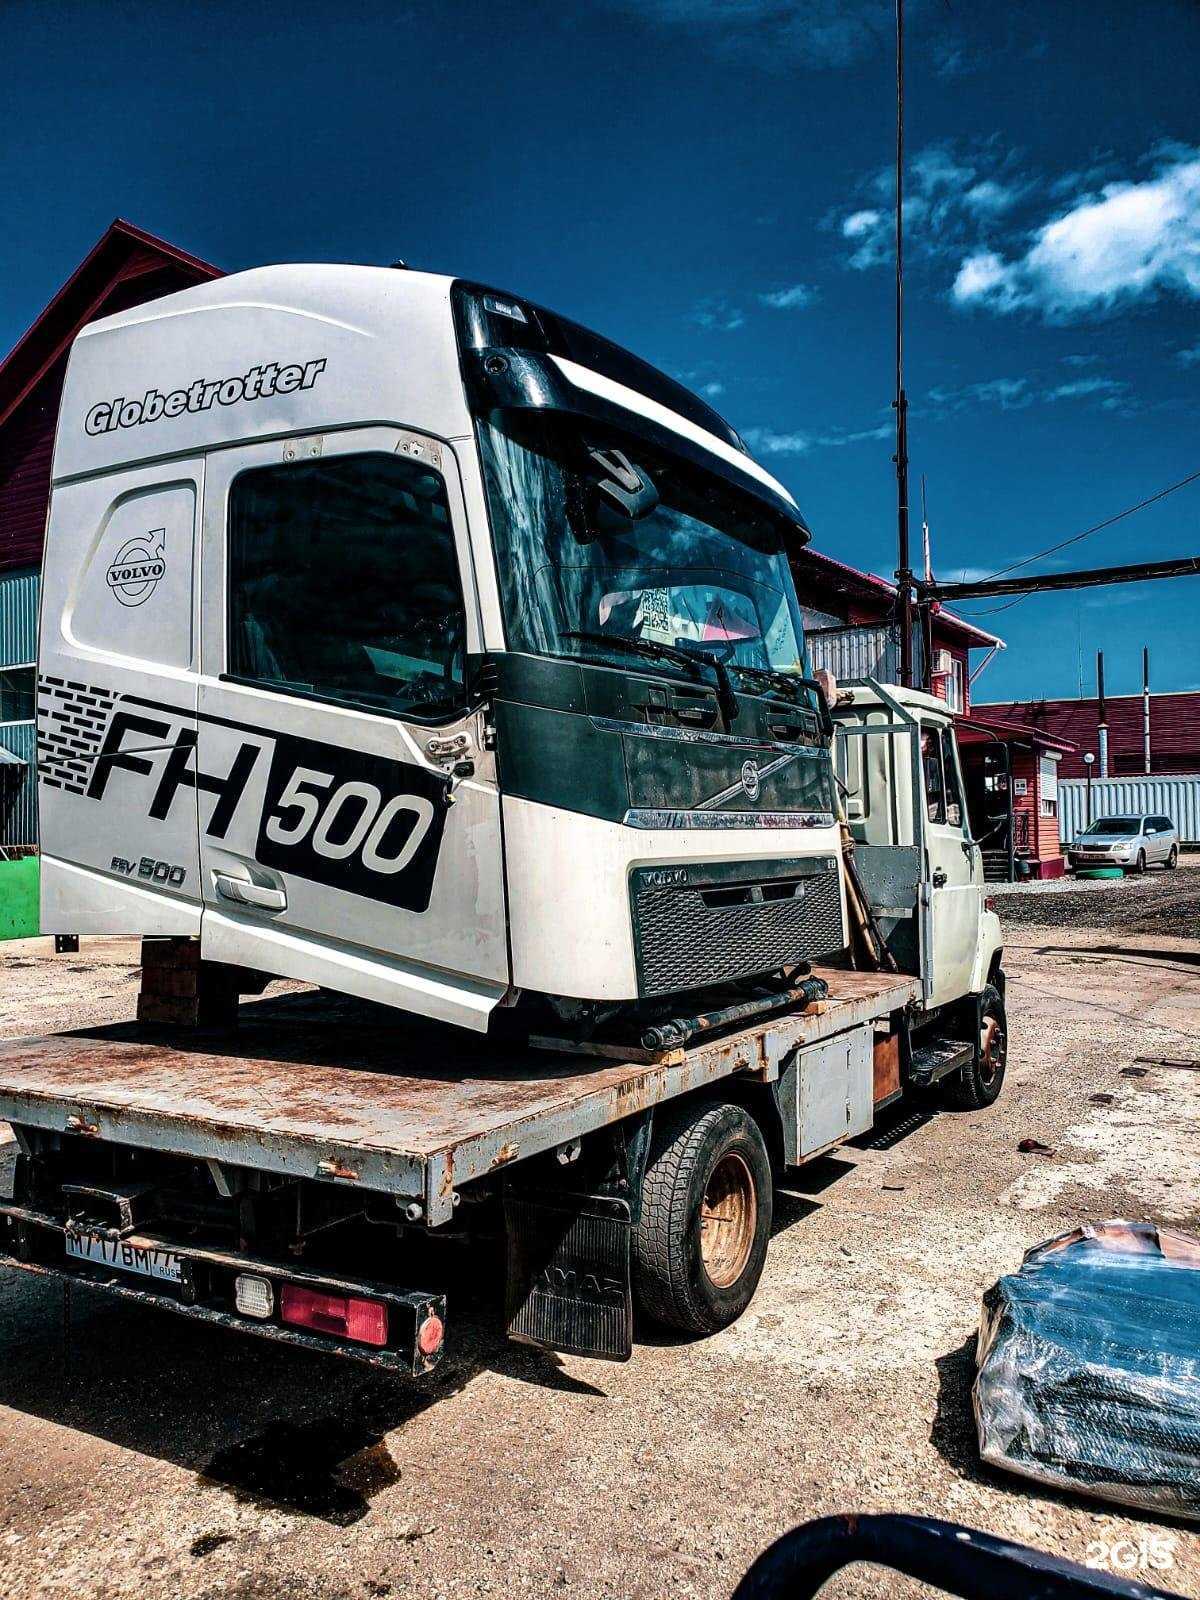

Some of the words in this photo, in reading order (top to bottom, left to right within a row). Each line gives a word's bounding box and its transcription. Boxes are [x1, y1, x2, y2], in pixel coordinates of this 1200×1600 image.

[85, 358, 327, 436] Globetrotter
[110, 565, 163, 581] VOLVO
[87, 711, 262, 839] FH
[266, 767, 434, 874] 500
[139, 856, 186, 888] 500
